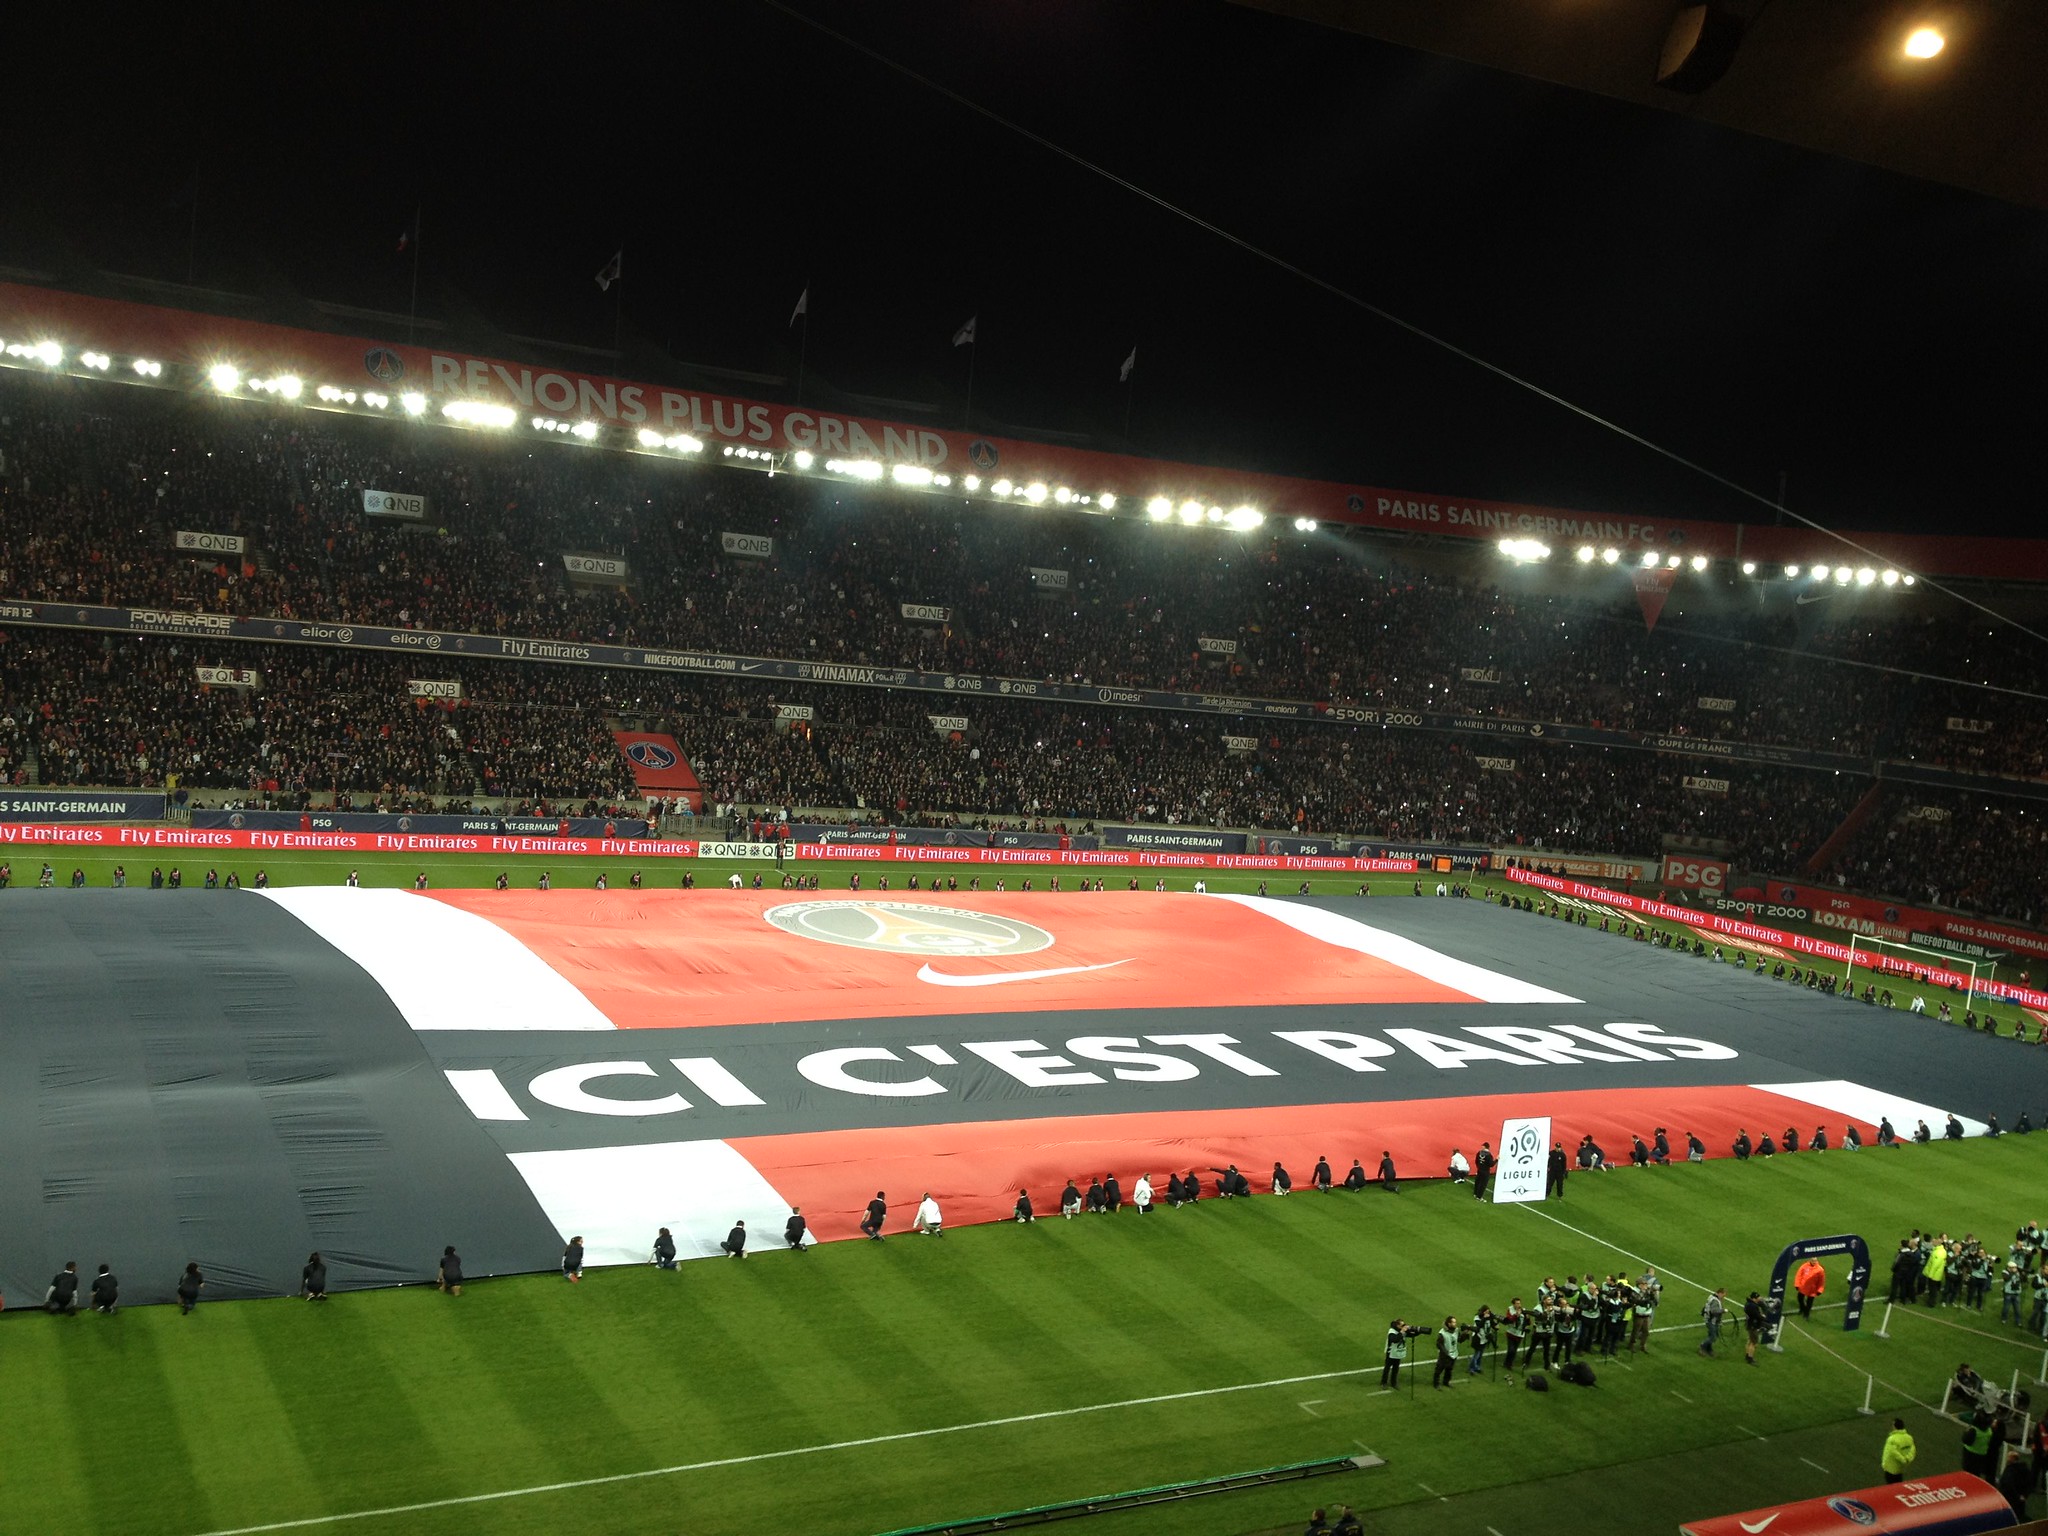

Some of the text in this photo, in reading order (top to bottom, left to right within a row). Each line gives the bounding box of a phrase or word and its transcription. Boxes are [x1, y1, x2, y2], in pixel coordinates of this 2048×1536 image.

[660, 392, 771, 442] PLUS
[782, 412, 948, 465] GRAND
[384, 498, 421, 513] QNB
[1377, 498, 1656, 542] PARIS SAINT-GERMAIN FC
[199, 536, 238, 550] QNB
[738, 538, 770, 553] QNB
[583, 560, 616, 573] QNB
[1040, 573, 1066, 586] QNB
[22, 608, 34, 619] 12
[130, 611, 231, 629] POWERADE
[300, 628, 336, 638] elior
[390, 634, 425, 645] elior
[501, 640, 591, 659] Fly Emirates
[1210, 641, 1235, 652] QNB
[643, 654, 737, 671] NIKEFOOTBALL.COM
[811, 665, 874, 683] WINAMAX
[423, 682, 456, 695] QNB
[957, 679, 983, 690] QNB
[1011, 684, 1037, 694] QNB
[782, 706, 809, 718] QNB
[940, 718, 965, 729] QNB
[1385, 712, 1424, 727] 2000
[1501, 724, 1526, 733] PARIS
[1231, 738, 1254, 748] QNB
[1488, 760, 1512, 769] QNB
[1698, 780, 1725, 790] QNB
[12, 801, 126, 813] SAINT-GERMAIN
[313, 818, 332, 828] PSG
[463, 821, 488, 830] PARIS
[0, 826, 103, 843] ly Emirates
[120, 829, 232, 845] Fly Emirates
[250, 831, 357, 848] Fly Emirates
[828, 831, 848, 839] PARIS
[1004, 836, 1019, 845] PSG
[1126, 833, 1223, 847] PARIS SAINT-GERMAIN
[376, 835, 477, 851] Fly Emirates
[492, 838, 588, 852] Fly Emirates
[601, 840, 691, 855] Fly Emirates
[714, 843, 747, 857] QNB
[1300, 845, 1318, 855] PSG
[801, 845, 881, 859] Fly Emirates
[895, 847, 970, 861] Fly Emirates
[980, 849, 1051, 863] Fly Emirates
[1061, 852, 1130, 864] Fly Emirates
[1389, 850, 1412, 861] PARIS
[1139, 853, 1205, 866] Fly Emirates
[1216, 855, 1279, 868] Fly Emirates
[1287, 857, 1347, 870] Fly Emirates
[1354, 859, 1413, 871] Fly Emirates
[1510, 869, 1525, 883] Fly
[1526, 871, 1564, 891] Emirates
[1668, 861, 1722, 887] PSG
[1573, 883, 1633, 907] Fly Emirates
[1716, 899, 1807, 919] SPORT 2000
[1831, 899, 1850, 909] PSG
[1641, 898, 1658, 916] Fly
[1659, 903, 1705, 925] Emirates
[1814, 910, 1876, 936] LOXAM
[1714, 917, 1732, 933] Fly
[1734, 921, 1783, 944] Emirates
[1946, 922, 2048, 953] PARIS SAINT-GERMAI
[1793, 936, 1813, 957] Fly
[1814, 941, 1868, 964] Emirates
[1911, 932, 1985, 957] NIKEFOOTBALL.COM
[1906, 960, 1963, 987] Emirates
[1975, 977, 2048, 1008] Fly Emirat
[443, 1022, 1740, 1121] ICI C'EST PARIS
[1503, 1171, 1533, 1180] LIGUE
[1894, 1487, 1967, 1508] Emirates
